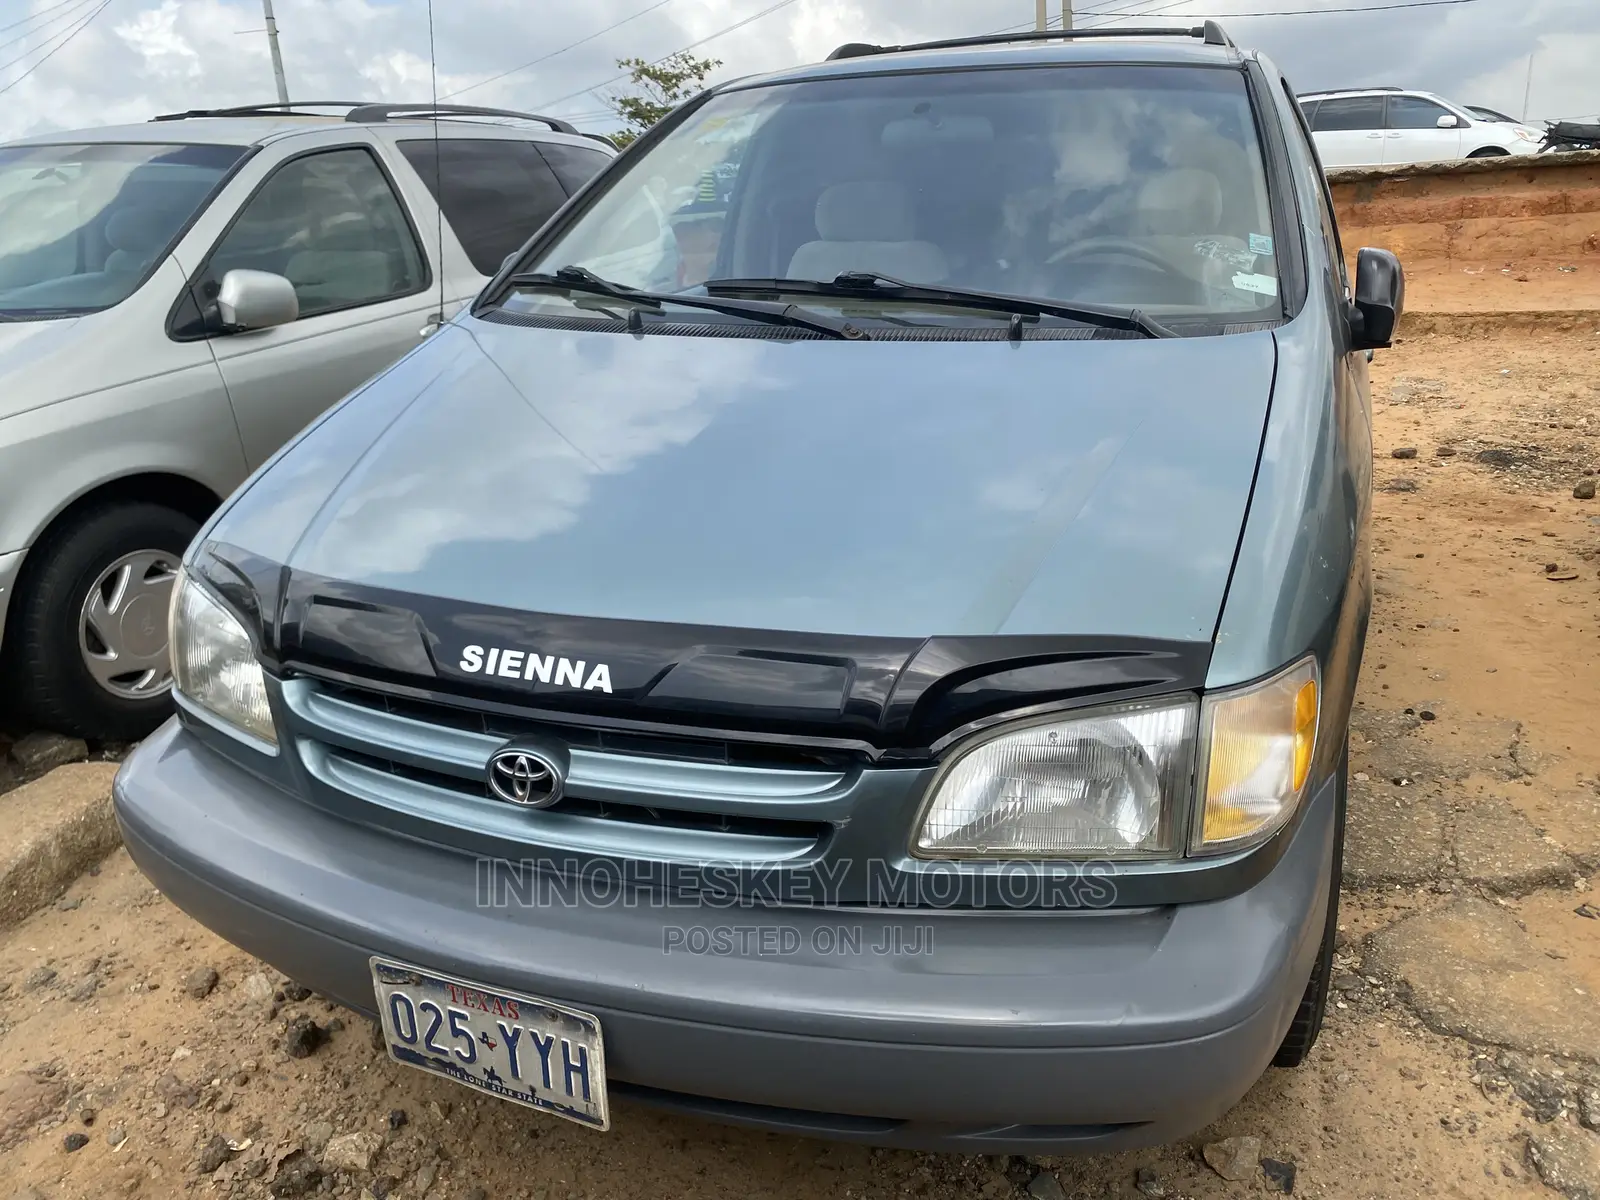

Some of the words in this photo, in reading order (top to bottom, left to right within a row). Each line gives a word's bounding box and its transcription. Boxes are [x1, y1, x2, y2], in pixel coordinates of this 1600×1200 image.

[459, 644, 613, 694] SIENNA
[445, 983, 520, 1020] TEXAS
[389, 991, 478, 1065] 025
[496, 1020, 592, 1103] YYH
[446, 1067, 461, 1079] THE
[464, 1074, 486, 1088] LONE
[491, 1085, 514, 1097] STAR
[516, 1093, 543, 1106] STATE
